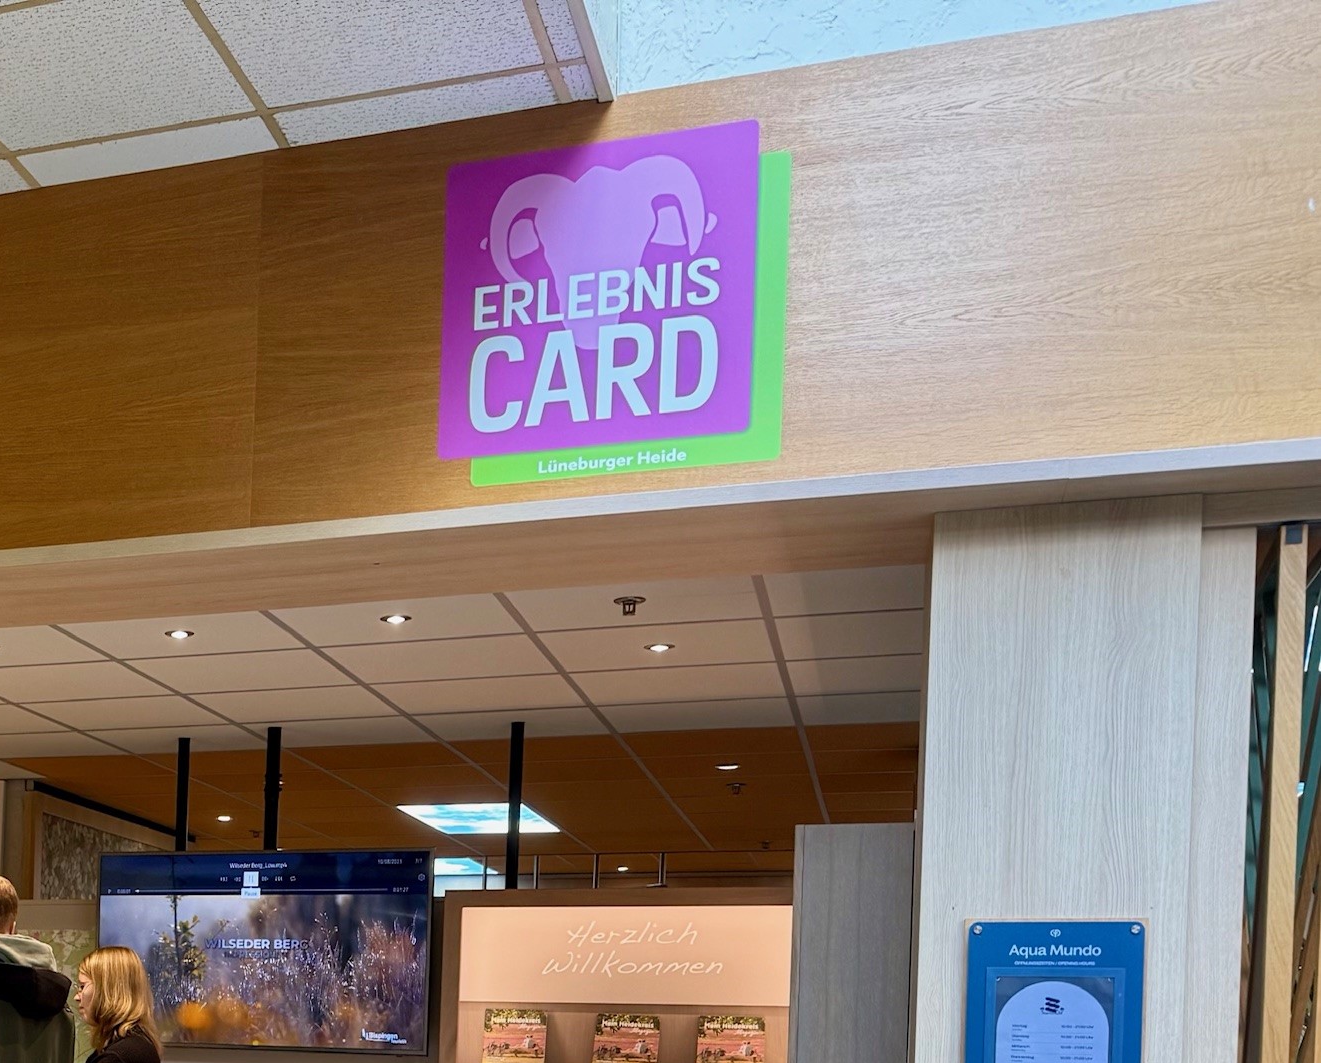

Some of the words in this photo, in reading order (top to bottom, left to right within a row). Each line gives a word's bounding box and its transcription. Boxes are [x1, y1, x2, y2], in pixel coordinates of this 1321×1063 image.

[473, 256, 721, 331] ERLEBNIS
[469, 314, 719, 433] CARD
[537, 453, 633, 474] Lüneburger
[636, 447, 688, 466] Heide
[205, 938, 270, 949] WILSEDER
[274, 938, 309, 950] BERG
[566, 920, 699, 948] Herzlich
[1008, 944, 1047, 959] Aqua
[1050, 944, 1102, 956] Mundo
